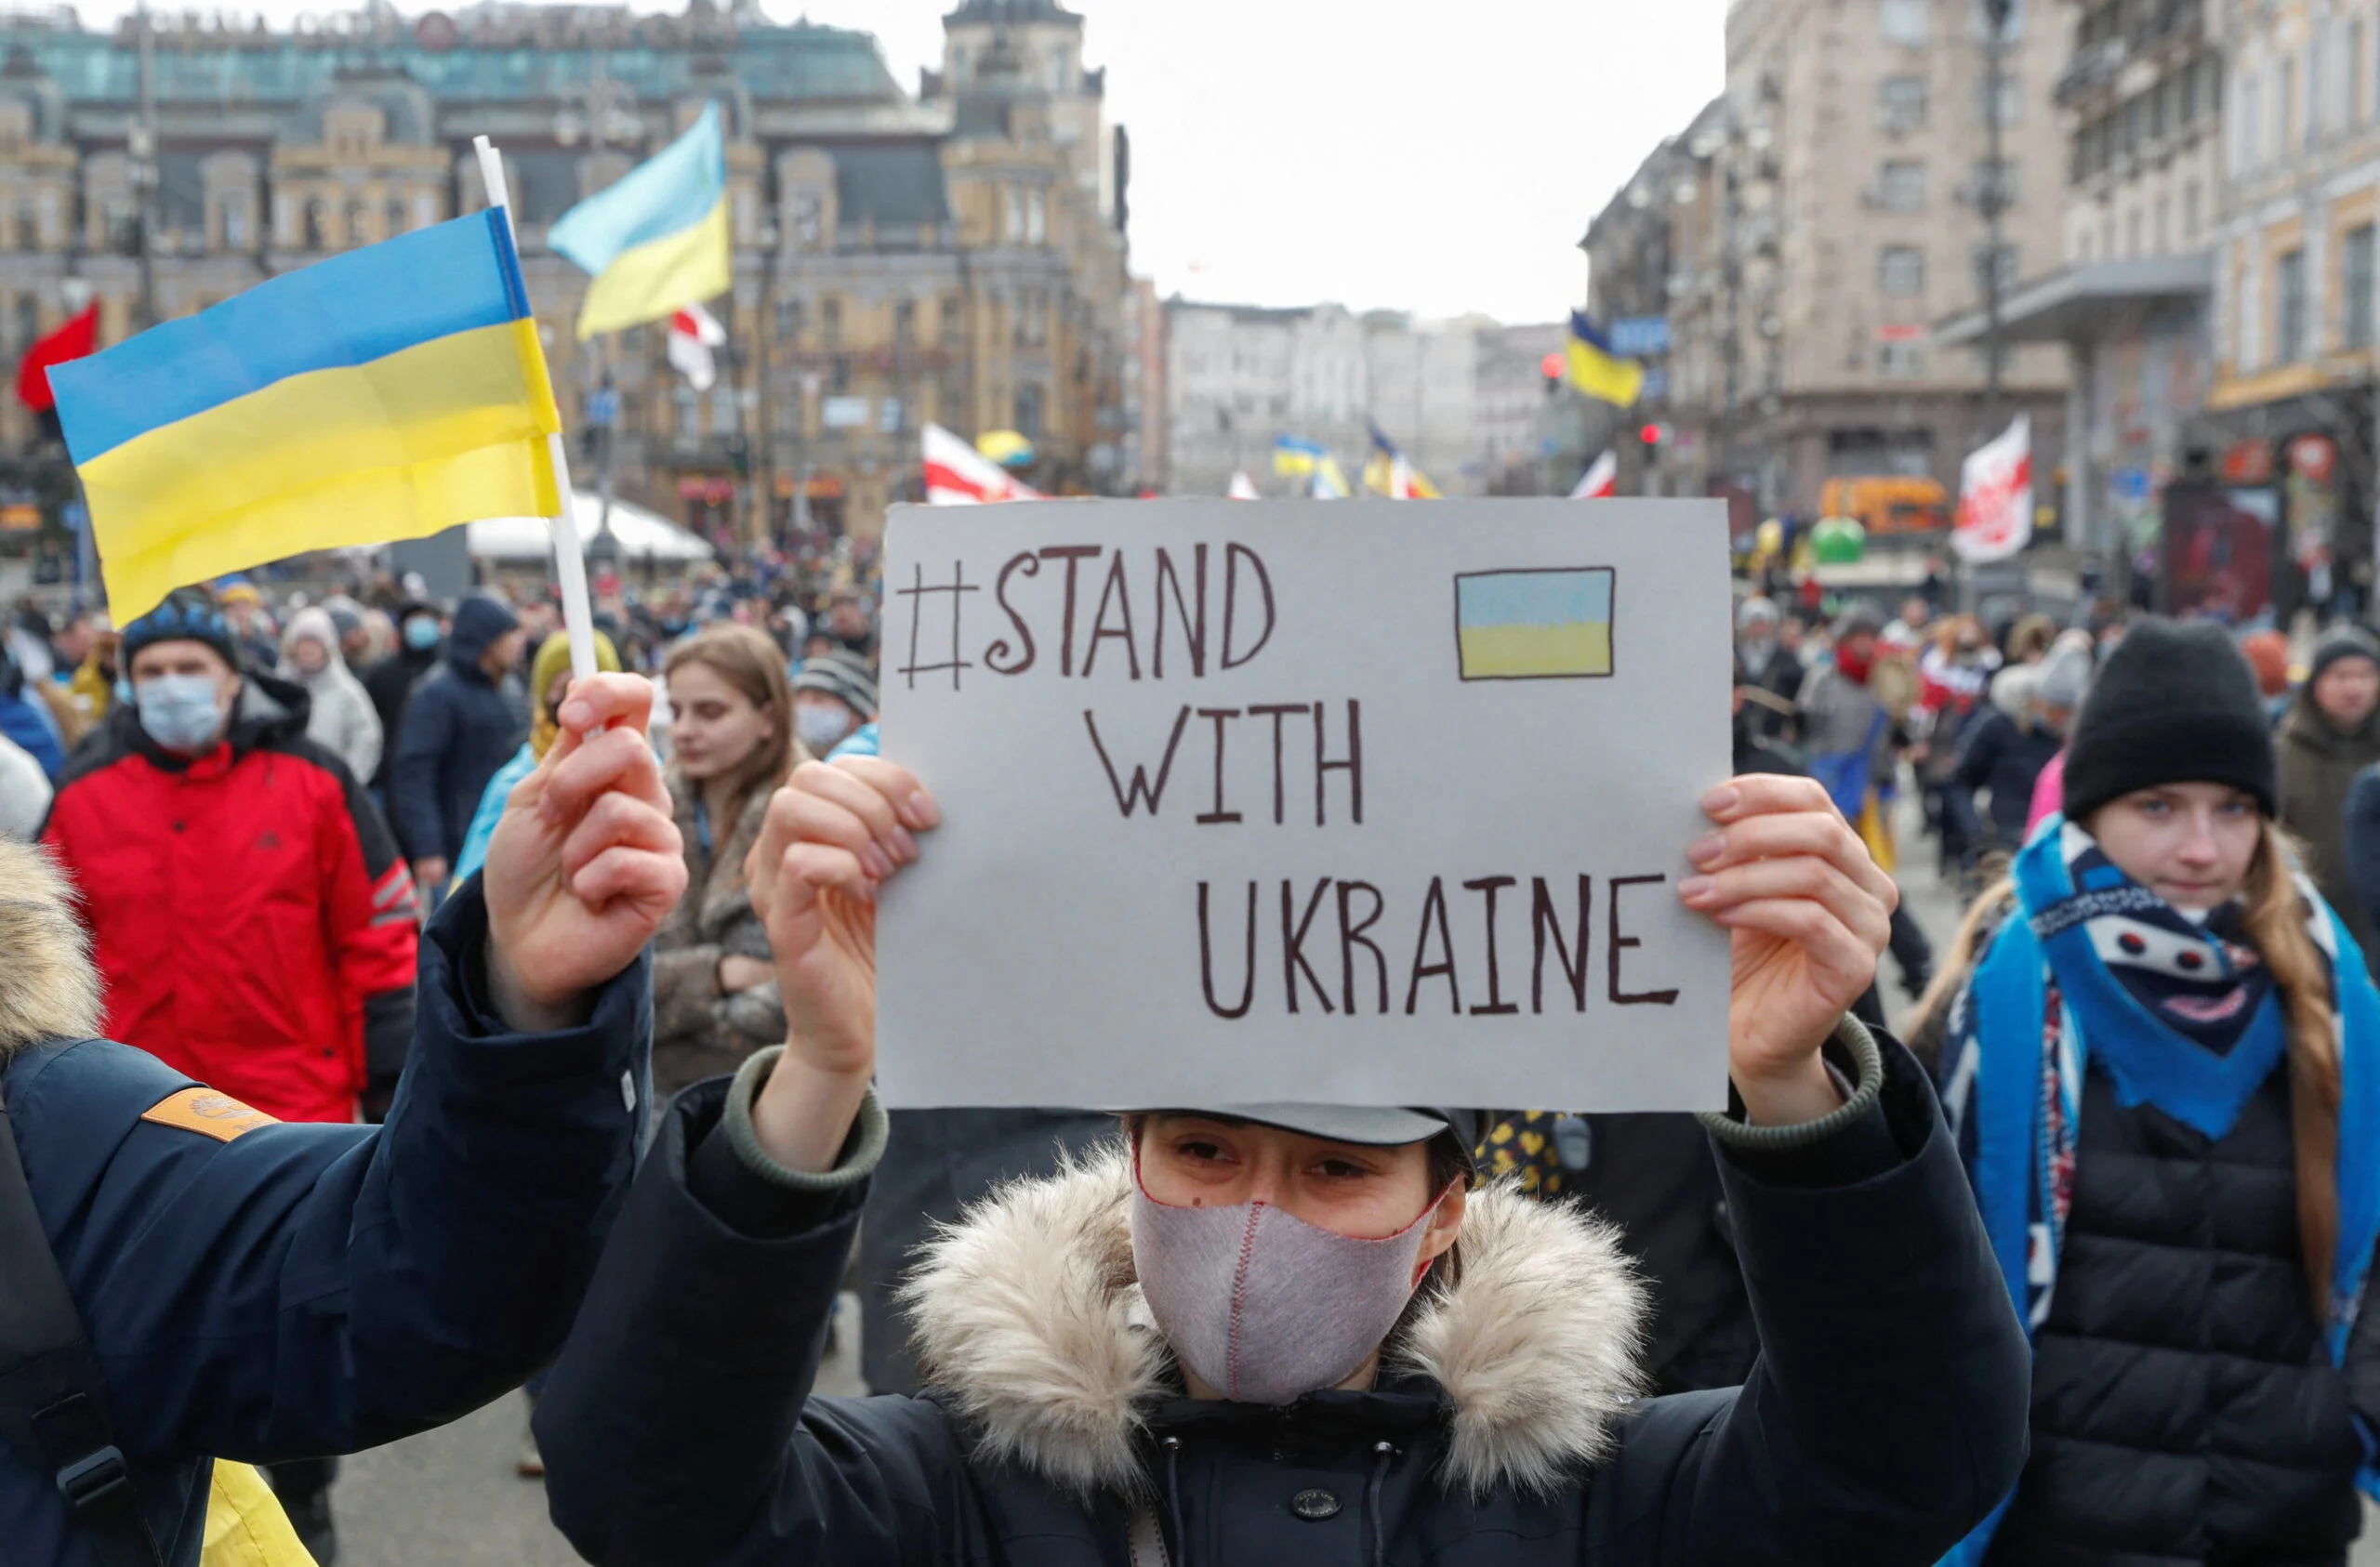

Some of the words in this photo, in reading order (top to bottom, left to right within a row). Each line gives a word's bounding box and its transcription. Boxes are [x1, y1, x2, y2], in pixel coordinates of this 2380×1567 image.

[897, 542, 1276, 690] #STAND
[1083, 699, 1363, 826] WITH
[1197, 873, 1679, 1020] UKRAINE
